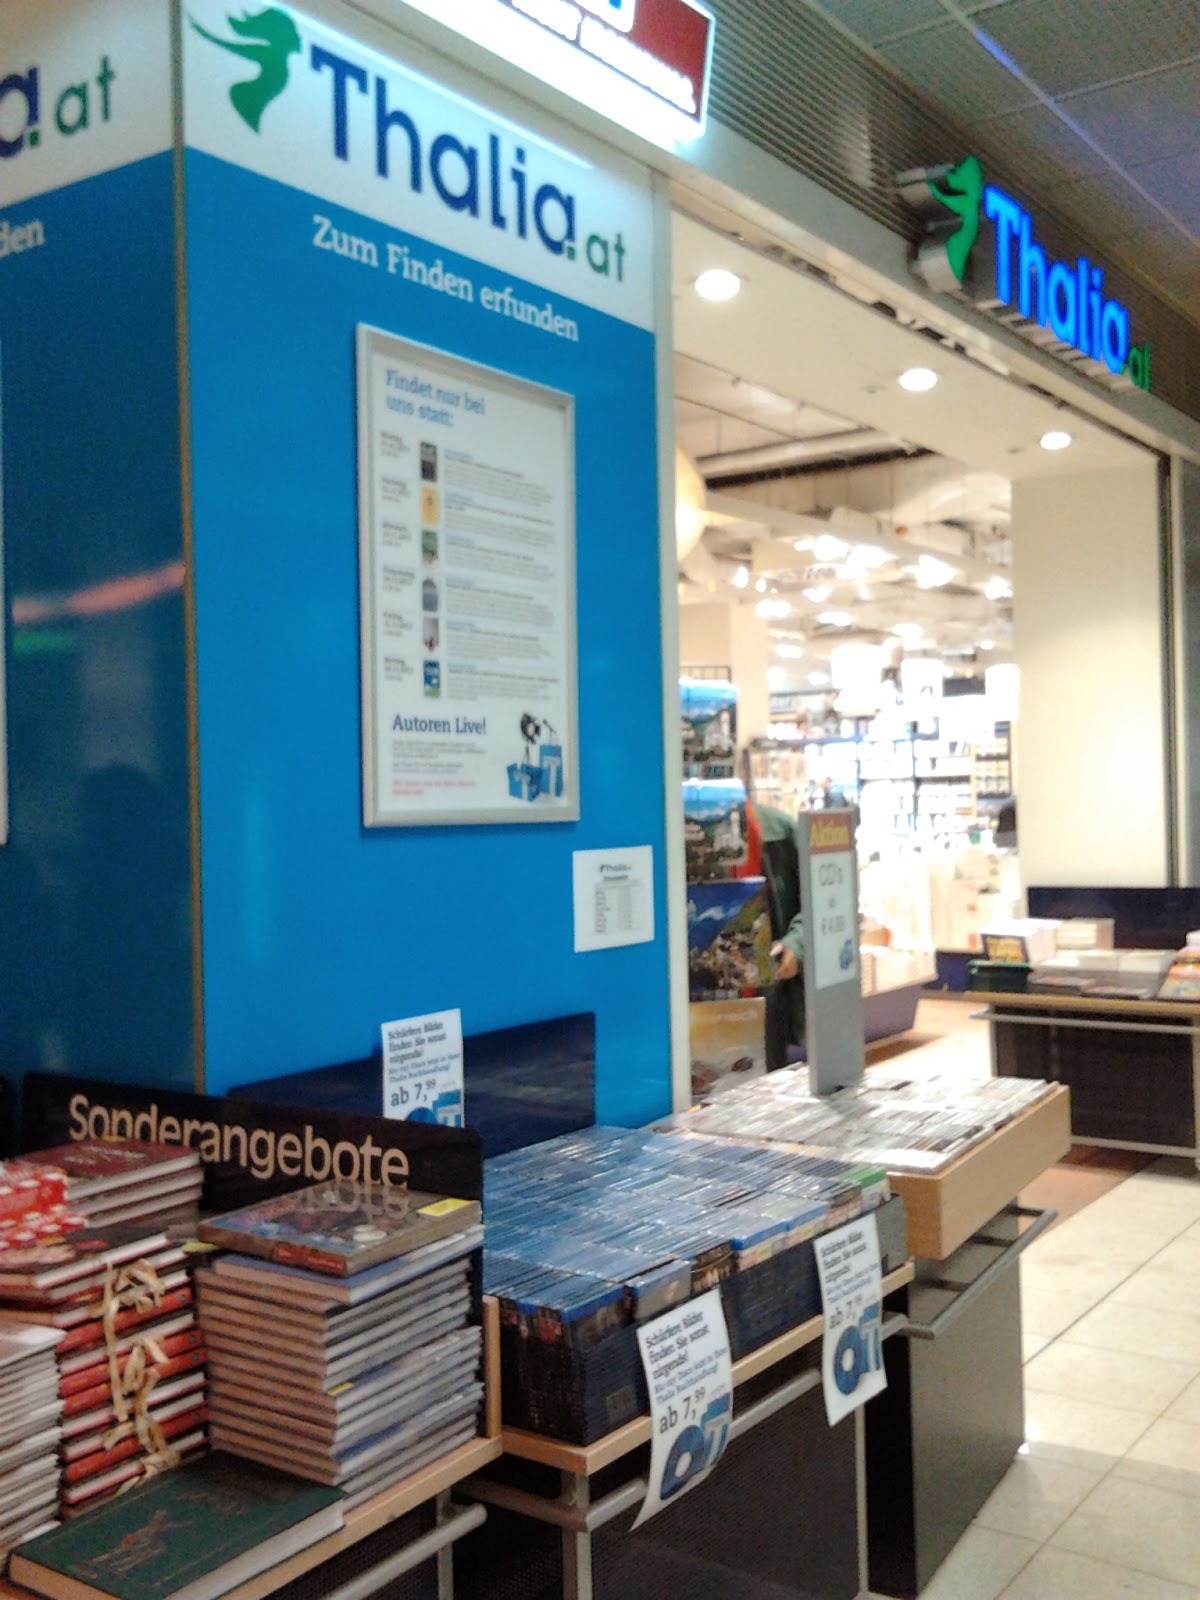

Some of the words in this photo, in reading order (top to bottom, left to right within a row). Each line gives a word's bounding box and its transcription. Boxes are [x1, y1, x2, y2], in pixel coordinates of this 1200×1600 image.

[312, 214, 378, 268] Zum
[386, 242, 473, 303] Finden
[480, 286, 579, 342] erfunden
[392, 713, 451, 733] Autoren
[455, 716, 487, 735] Live!
[391, 1086, 409, 1107] ab
[69, 1094, 409, 1189] Sonderangebote
[660, 1405, 678, 1434] ab
